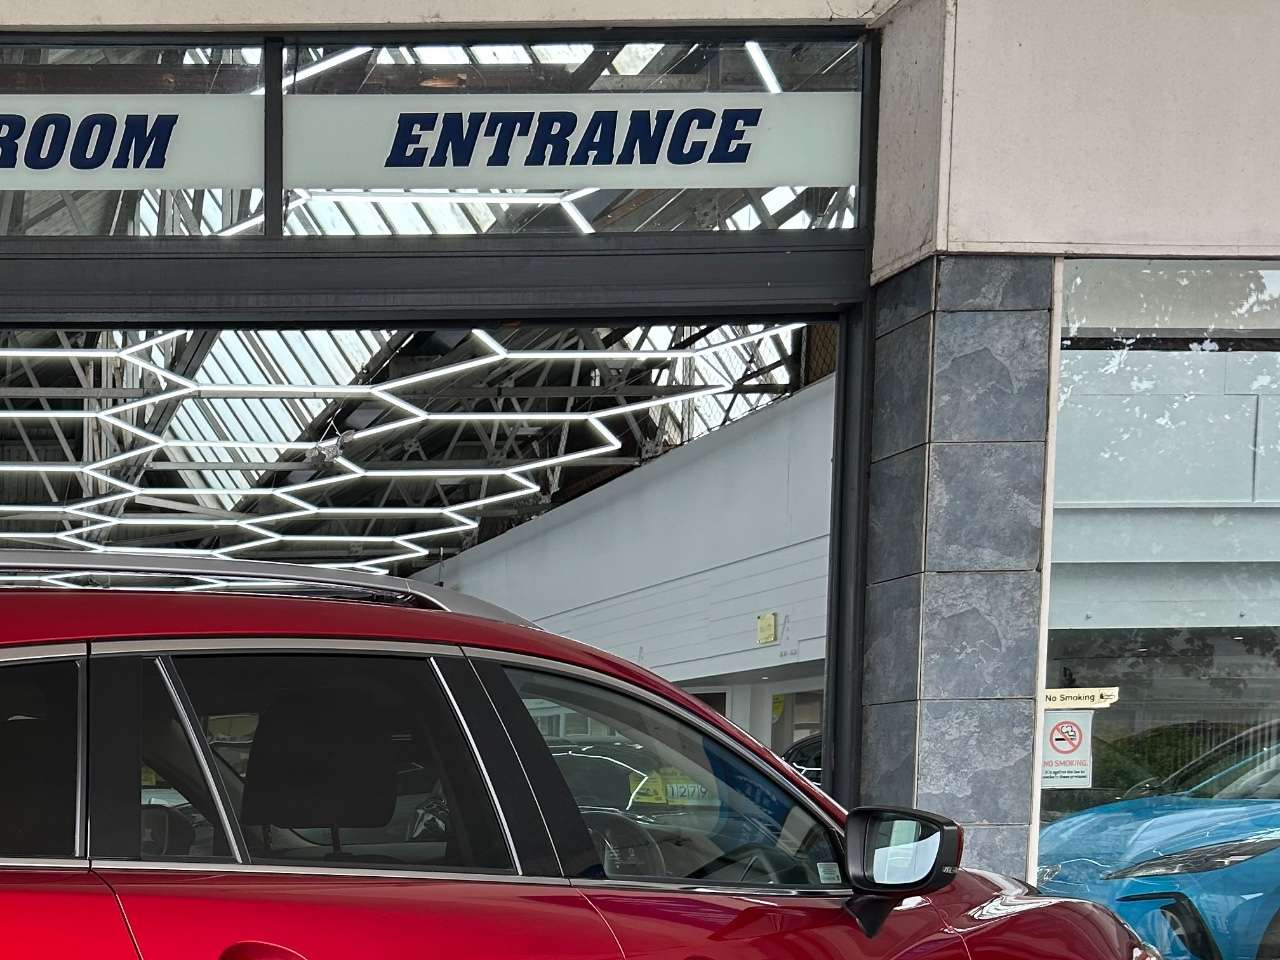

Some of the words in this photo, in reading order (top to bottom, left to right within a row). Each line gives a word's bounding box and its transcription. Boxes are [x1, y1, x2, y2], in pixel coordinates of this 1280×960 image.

[384, 108, 762, 167] ENTRANCE
[1045, 694, 1057, 702] No
[1060, 693, 1095, 703] Smoking
